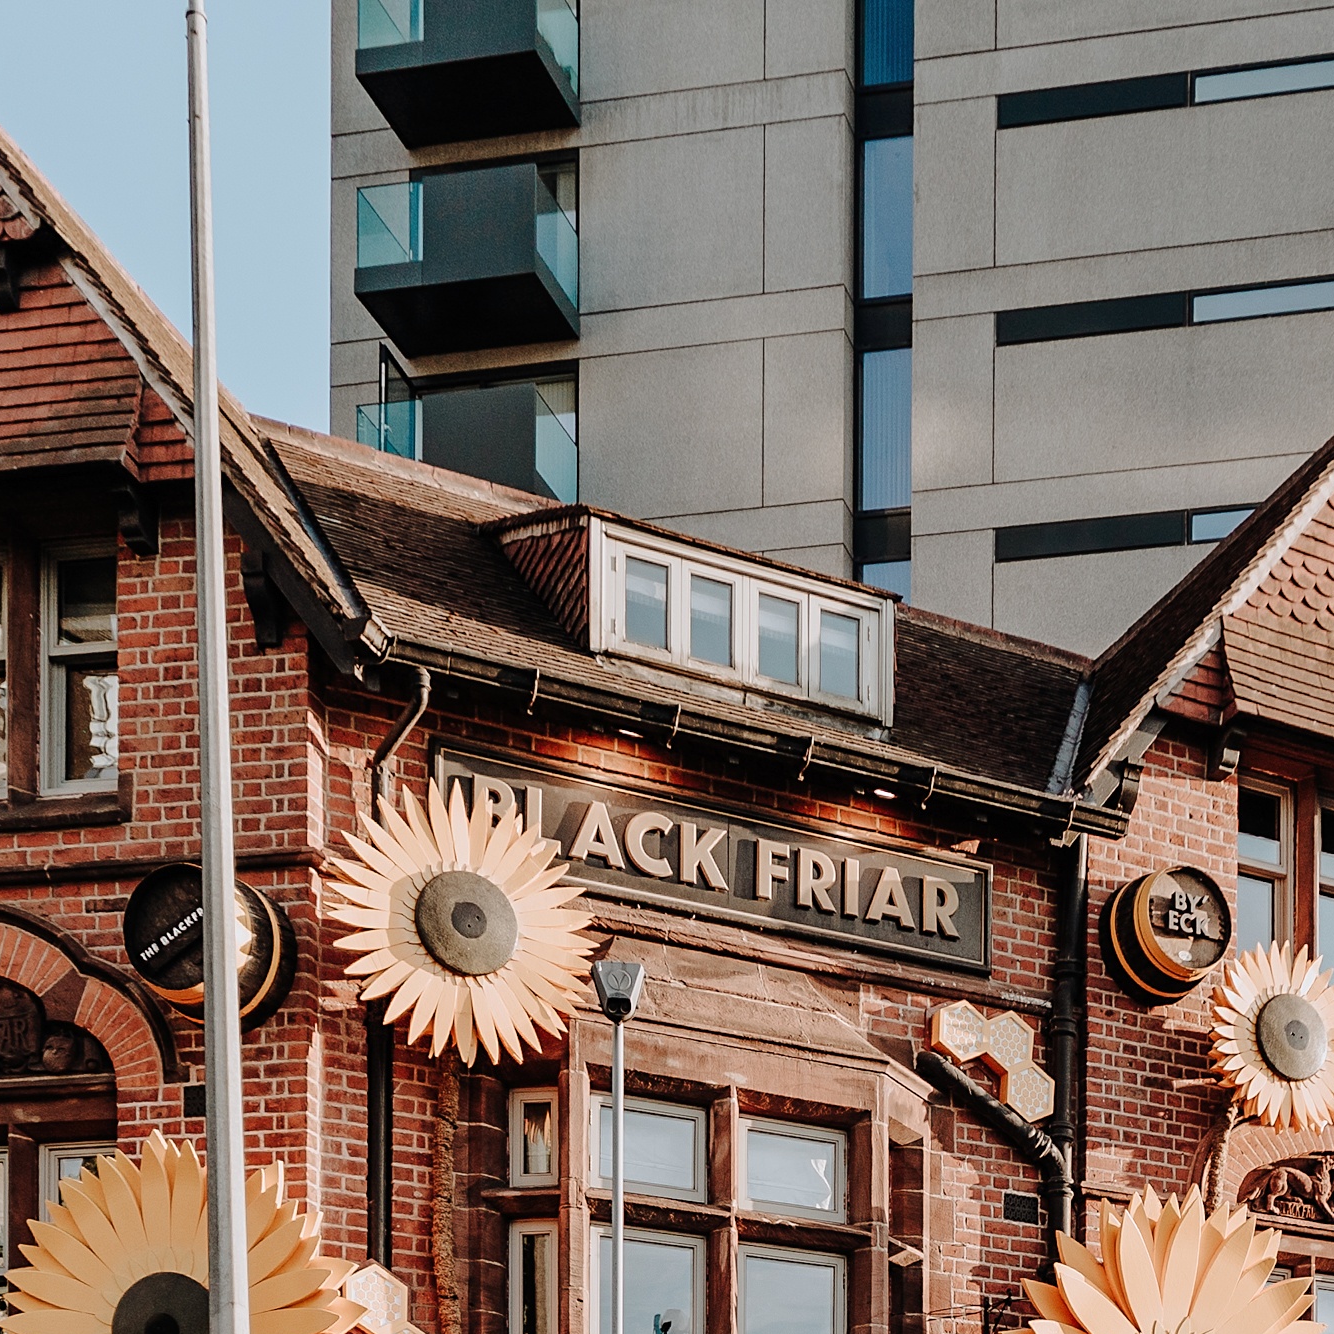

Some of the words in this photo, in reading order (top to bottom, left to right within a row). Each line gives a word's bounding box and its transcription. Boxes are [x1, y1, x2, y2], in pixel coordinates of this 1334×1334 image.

[473, 773, 730, 892] BLACK
[756, 838, 961, 940] FRIAR
[140, 943, 160, 961] THE
[160, 907, 204, 946] BLACKFR
[1168, 910, 1210, 936] ECK
